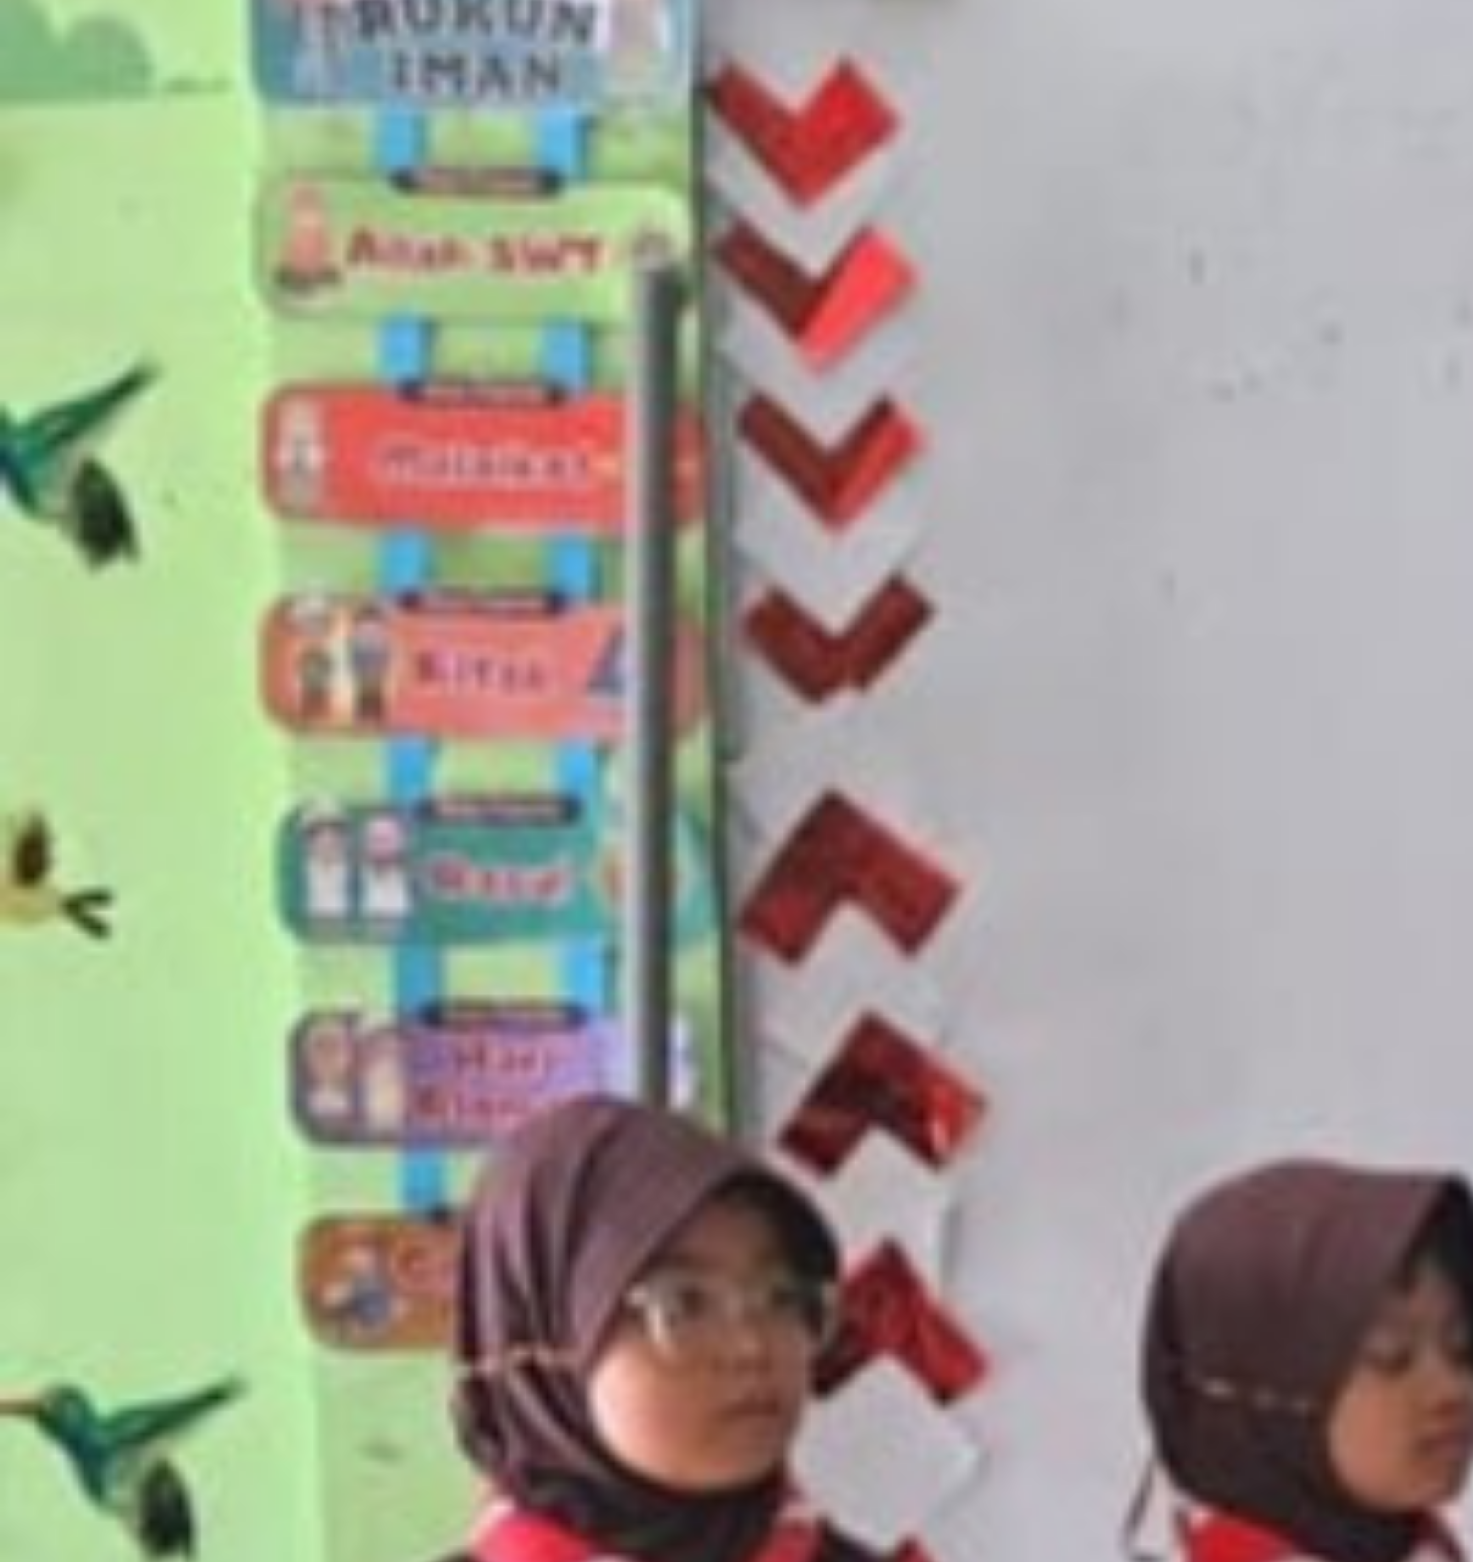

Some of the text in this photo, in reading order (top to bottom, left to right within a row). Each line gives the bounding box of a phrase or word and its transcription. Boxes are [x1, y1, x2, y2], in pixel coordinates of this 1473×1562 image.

[356, 0, 597, 42] RUKUN
[391, 53, 562, 93] IMAN
[345, 230, 604, 272] Allah SWT
